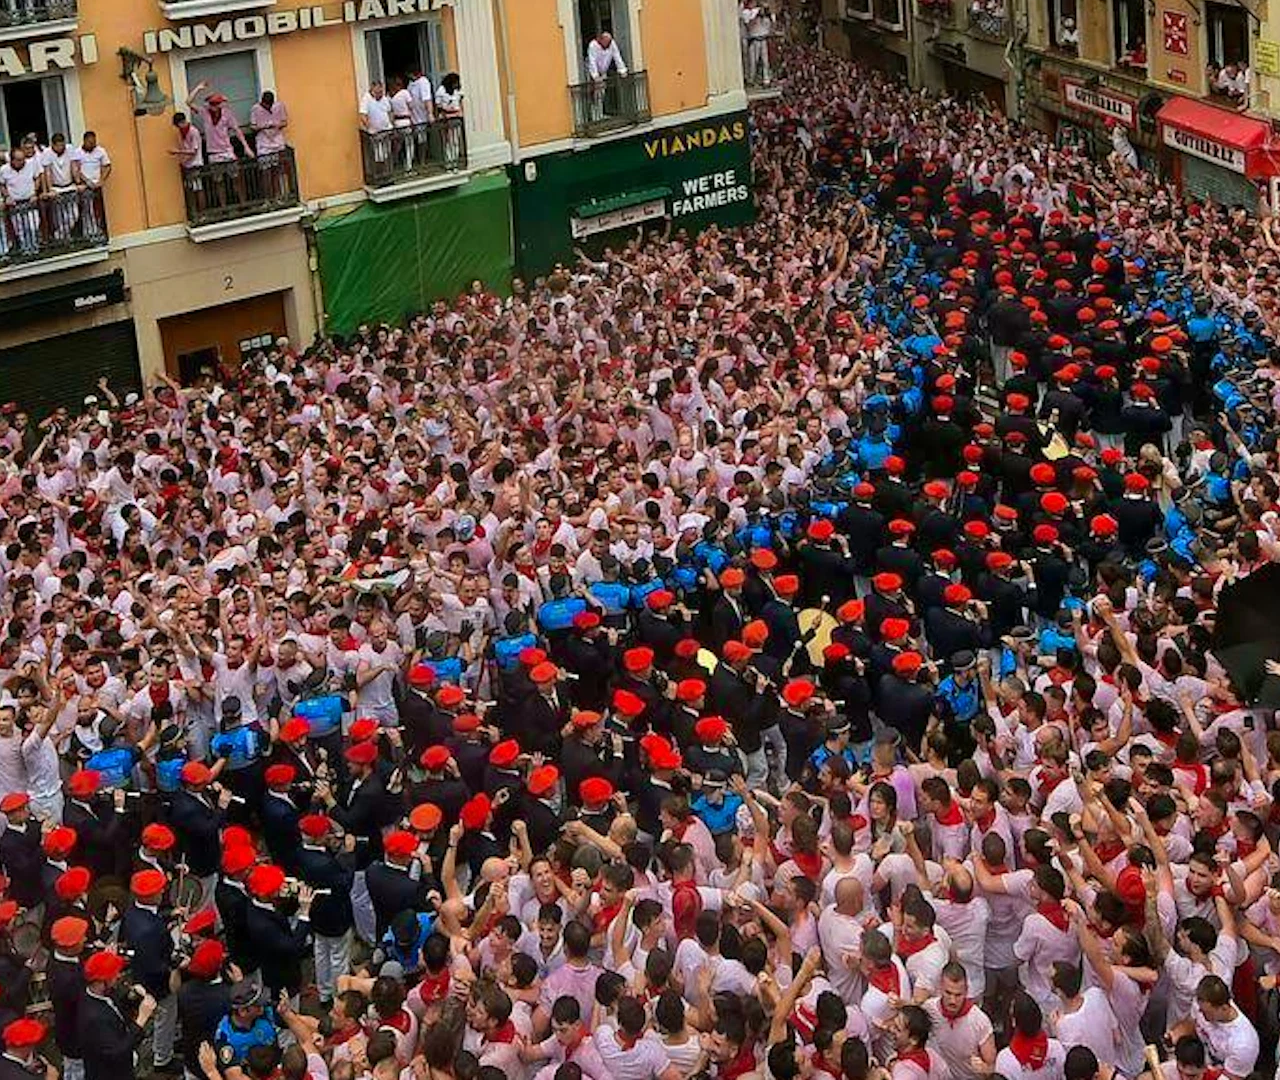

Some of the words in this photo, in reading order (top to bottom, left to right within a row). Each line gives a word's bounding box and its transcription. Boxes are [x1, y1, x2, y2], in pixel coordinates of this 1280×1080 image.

[644, 122, 745, 159] VIANDAS
[682, 170, 736, 196] WE'RE
[672, 185, 748, 217] FARMERS
[224, 276, 233, 291] 2
